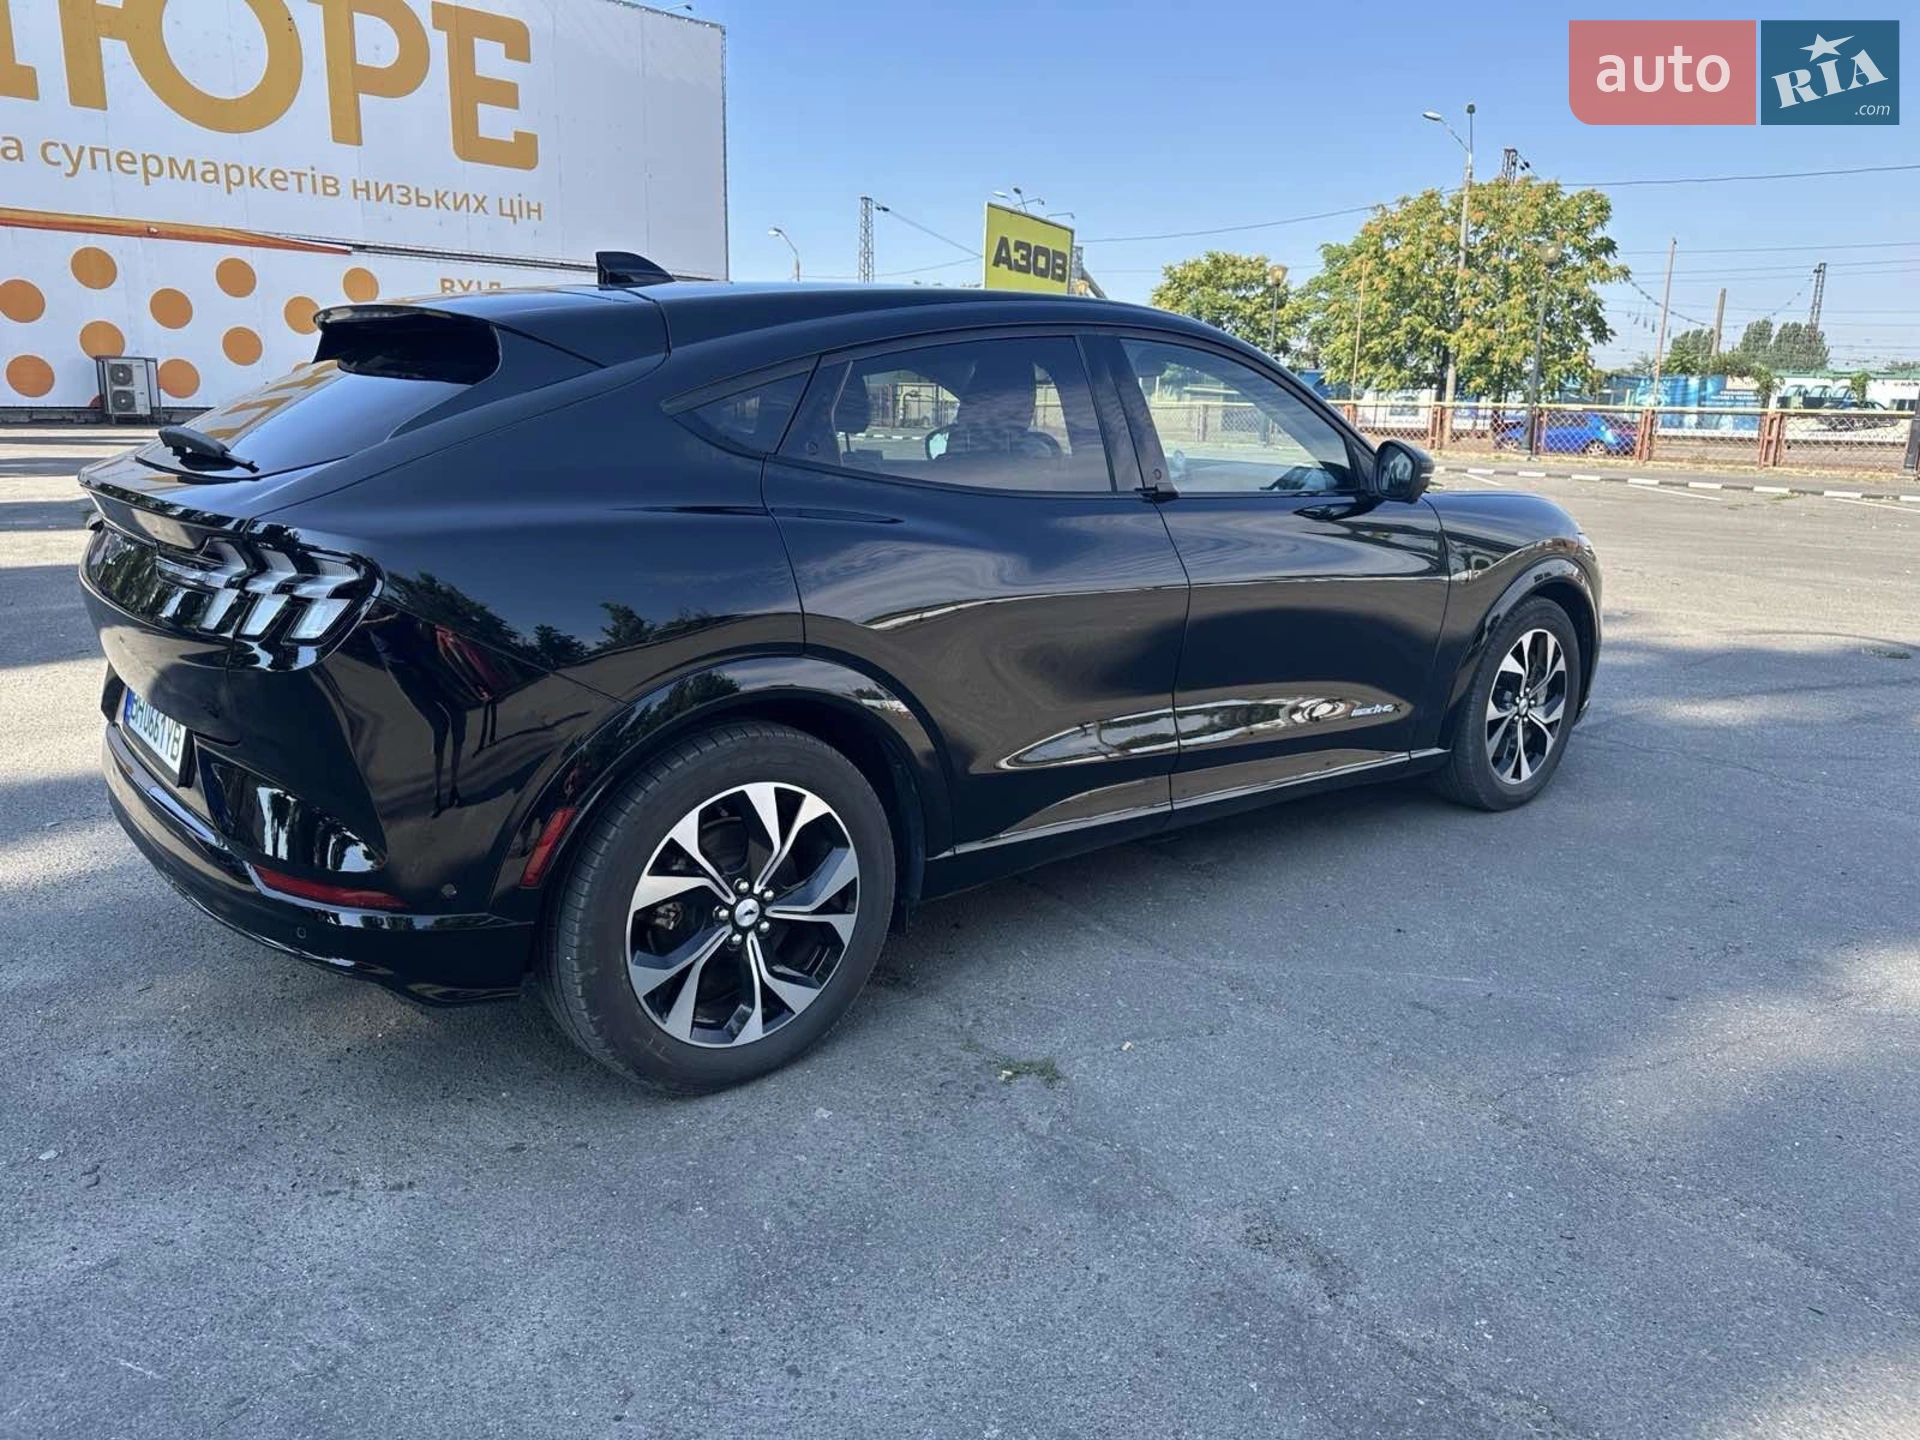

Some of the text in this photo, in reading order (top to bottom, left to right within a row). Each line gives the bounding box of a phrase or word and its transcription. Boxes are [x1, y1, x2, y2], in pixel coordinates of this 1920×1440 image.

[40, 139, 341, 196] супермаркетів
[352, 178, 490, 215] низьких
[498, 193, 543, 225] цін
[992, 235, 1068, 283] АЗОВ
